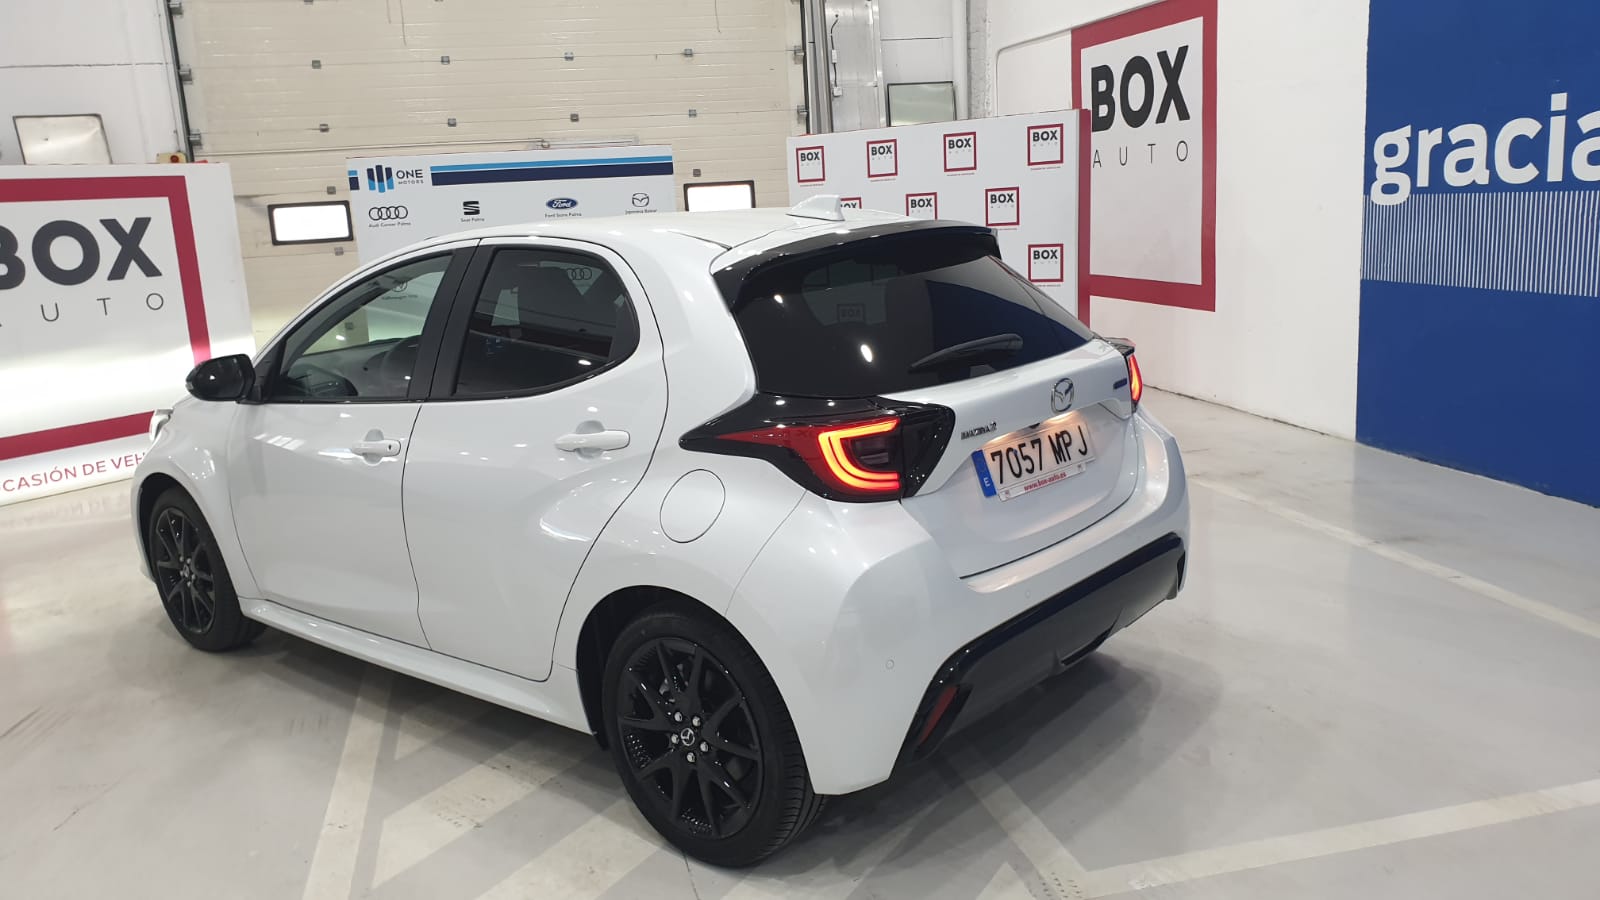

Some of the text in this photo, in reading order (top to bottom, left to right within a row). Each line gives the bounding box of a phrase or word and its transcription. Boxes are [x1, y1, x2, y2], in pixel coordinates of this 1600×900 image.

[1091, 45, 1191, 133] BOX
[1032, 130, 1058, 142] BOX
[948, 137, 972, 149] BOX
[871, 145, 893, 156] BOX
[1092, 140, 1189, 169] AUTO
[800, 151, 820, 162] BOX
[396, 169, 423, 180] ONE
[552, 199, 572, 208] Ford
[910, 198, 933, 208] BOX
[990, 193, 1015, 204] BOX
[1033, 249, 1058, 260] BOX
[0, 293, 164, 327] UTO
[990, 437, 1043, 485] 7057
[82, 460, 107, 476] DE
[983, 477, 991, 488] E
